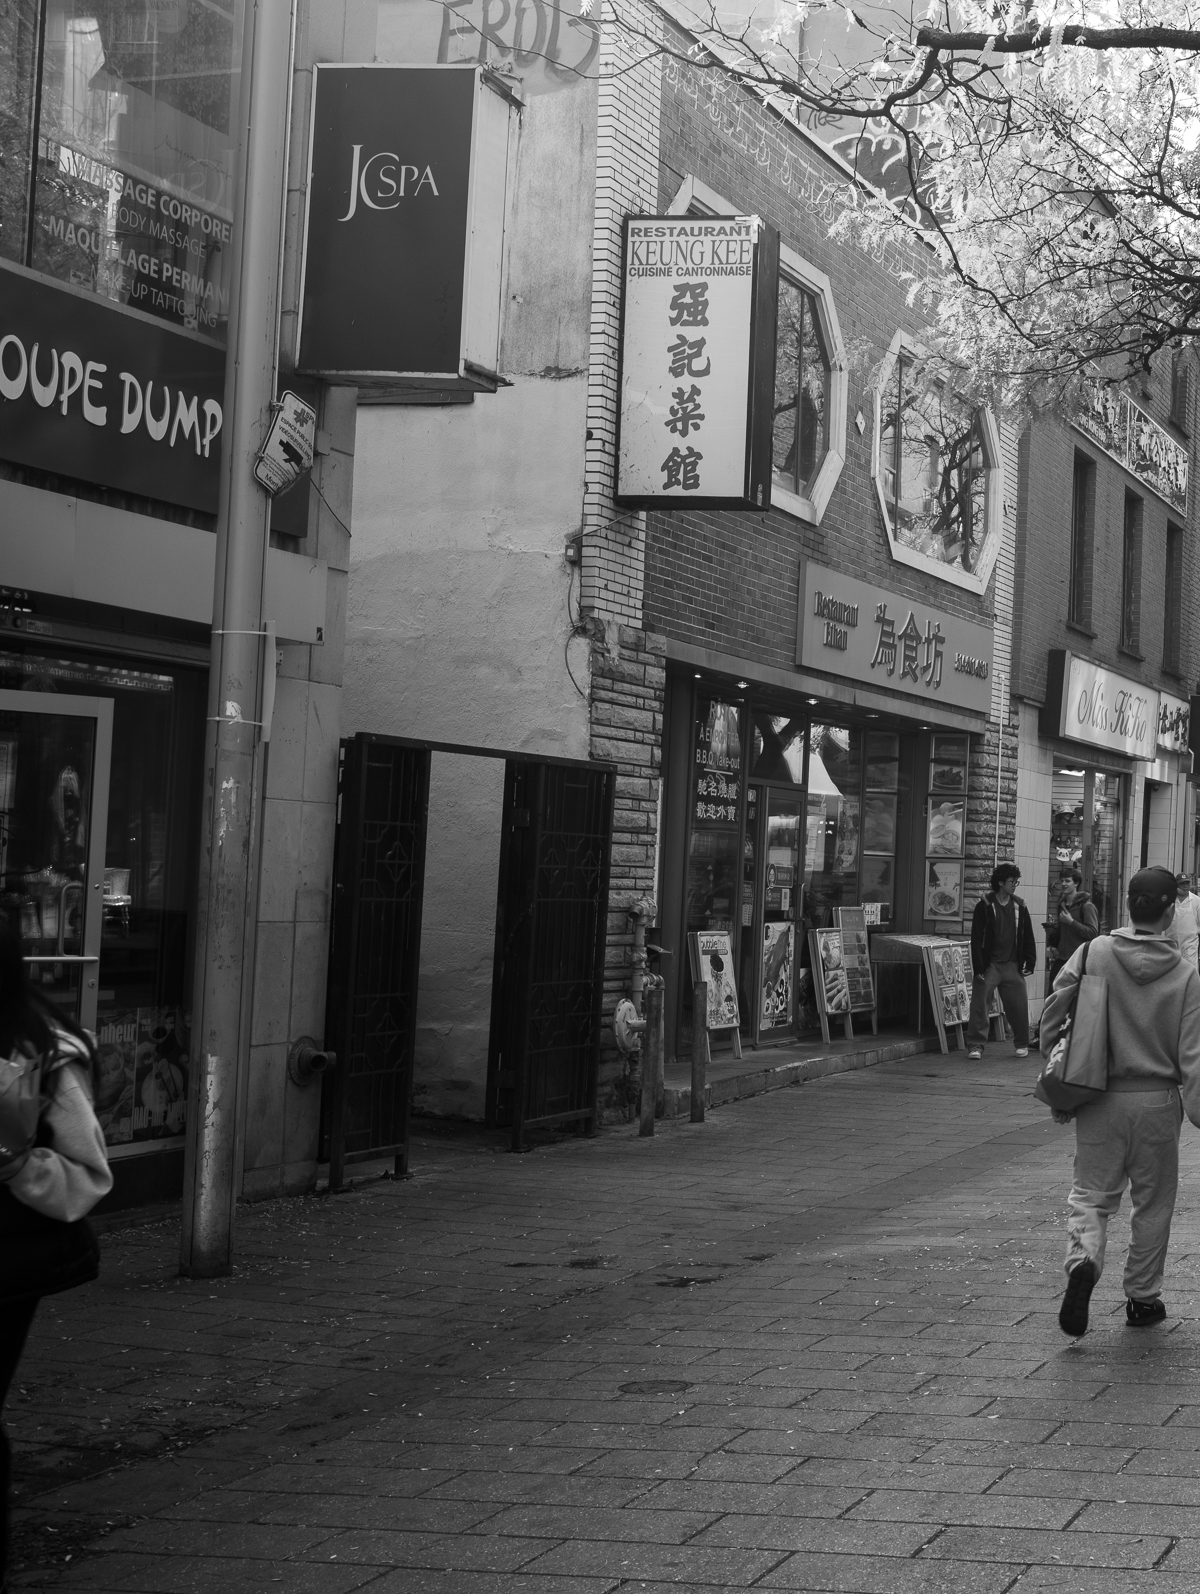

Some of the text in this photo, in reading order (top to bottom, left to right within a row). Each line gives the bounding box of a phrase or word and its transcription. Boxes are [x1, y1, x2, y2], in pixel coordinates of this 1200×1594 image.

[48, 214, 160, 279] MAQULLAGE
[112, 202, 206, 259] BODY MASSAGE
[630, 226, 752, 238] RESTAURANT
[629, 266, 752, 278] CUISINE CANTONNAISE
[630, 240, 752, 266] KEUNG KEE
[150, 287, 217, 328] TATTOOING
[119, 372, 223, 458] DUMP
[814, 590, 859, 628] Restaurant
[823, 621, 848, 651] Ethan
[870, 602, 946, 690] 為食坊
[1077, 680, 1109, 731] Miss
[1109, 689, 1148, 742] KiKo
